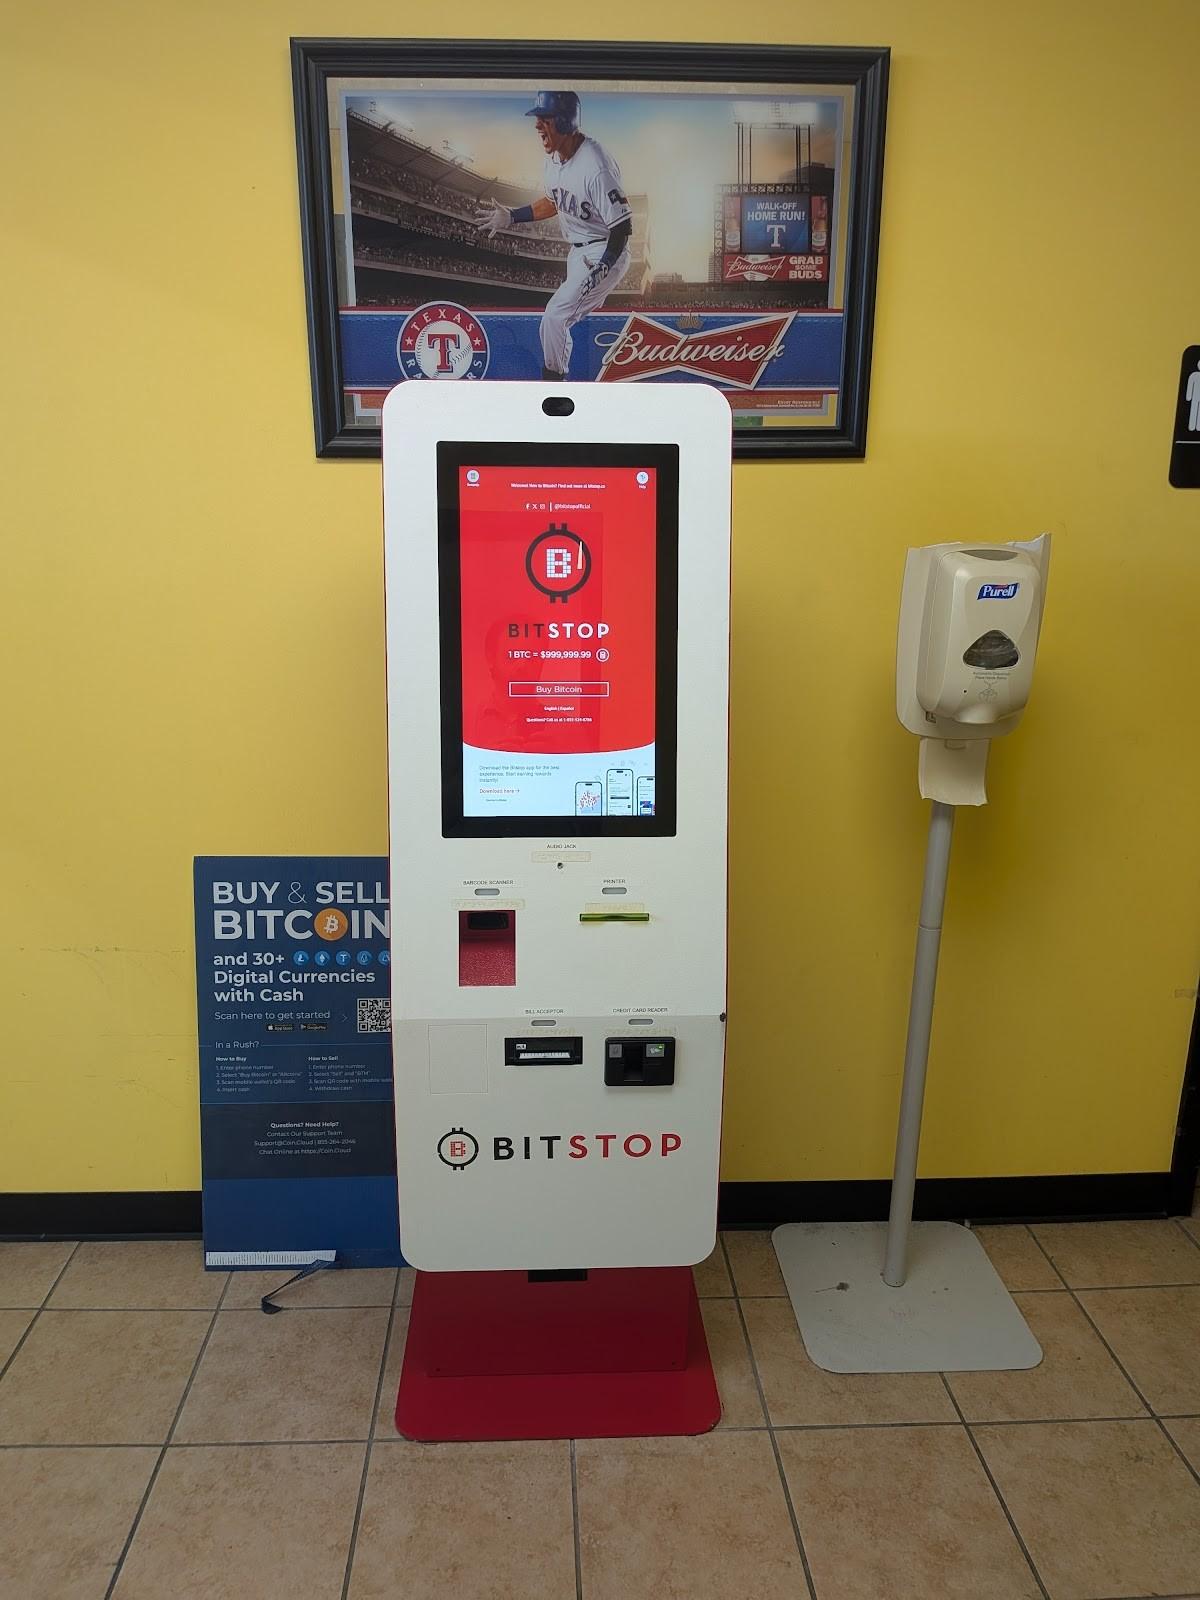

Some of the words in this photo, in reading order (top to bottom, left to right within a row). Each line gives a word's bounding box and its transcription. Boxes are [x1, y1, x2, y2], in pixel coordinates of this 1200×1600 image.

[757, 202, 797, 210] WALK-OFF
[747, 211, 779, 221] HOME
[780, 211, 805, 221] RUN!
[766, 224, 786, 248] T
[728, 260, 782, 272] Budweiser
[789, 256, 823, 265] GRAB
[789, 271, 822, 279] BUDS
[411, 308, 475, 332] TEXAS
[428, 332, 460, 373] T
[594, 331, 785, 366] Budweiser
[983, 585, 1015, 597] Purell
[508, 623, 610, 639] BITSTOP
[540, 650, 592, 659] $999,999.99
[536, 686, 552, 694] Buy
[554, 685, 583, 693] Bitcoin
[213, 881, 281, 904] BUY
[288, 881, 308, 904] &
[315, 881, 390, 904] SELL
[214, 952, 247, 966] and
[252, 952, 285, 966] 30+
[214, 970, 274, 987] Digital
[278, 969, 375, 984] Currencies
[214, 988, 255, 1002] with
[260, 988, 304, 1002] Cash
[214, 1012, 239, 1020] Scan
[241, 1011, 262, 1020] here
[265, 1012, 275, 1020] to
[277, 1012, 294, 1022] get
[295, 1010, 331, 1019] started
[216, 1041, 224, 1049] In
[233, 1040, 259, 1049] Rush?
[493, 1133, 682, 1160] BITSTOP
